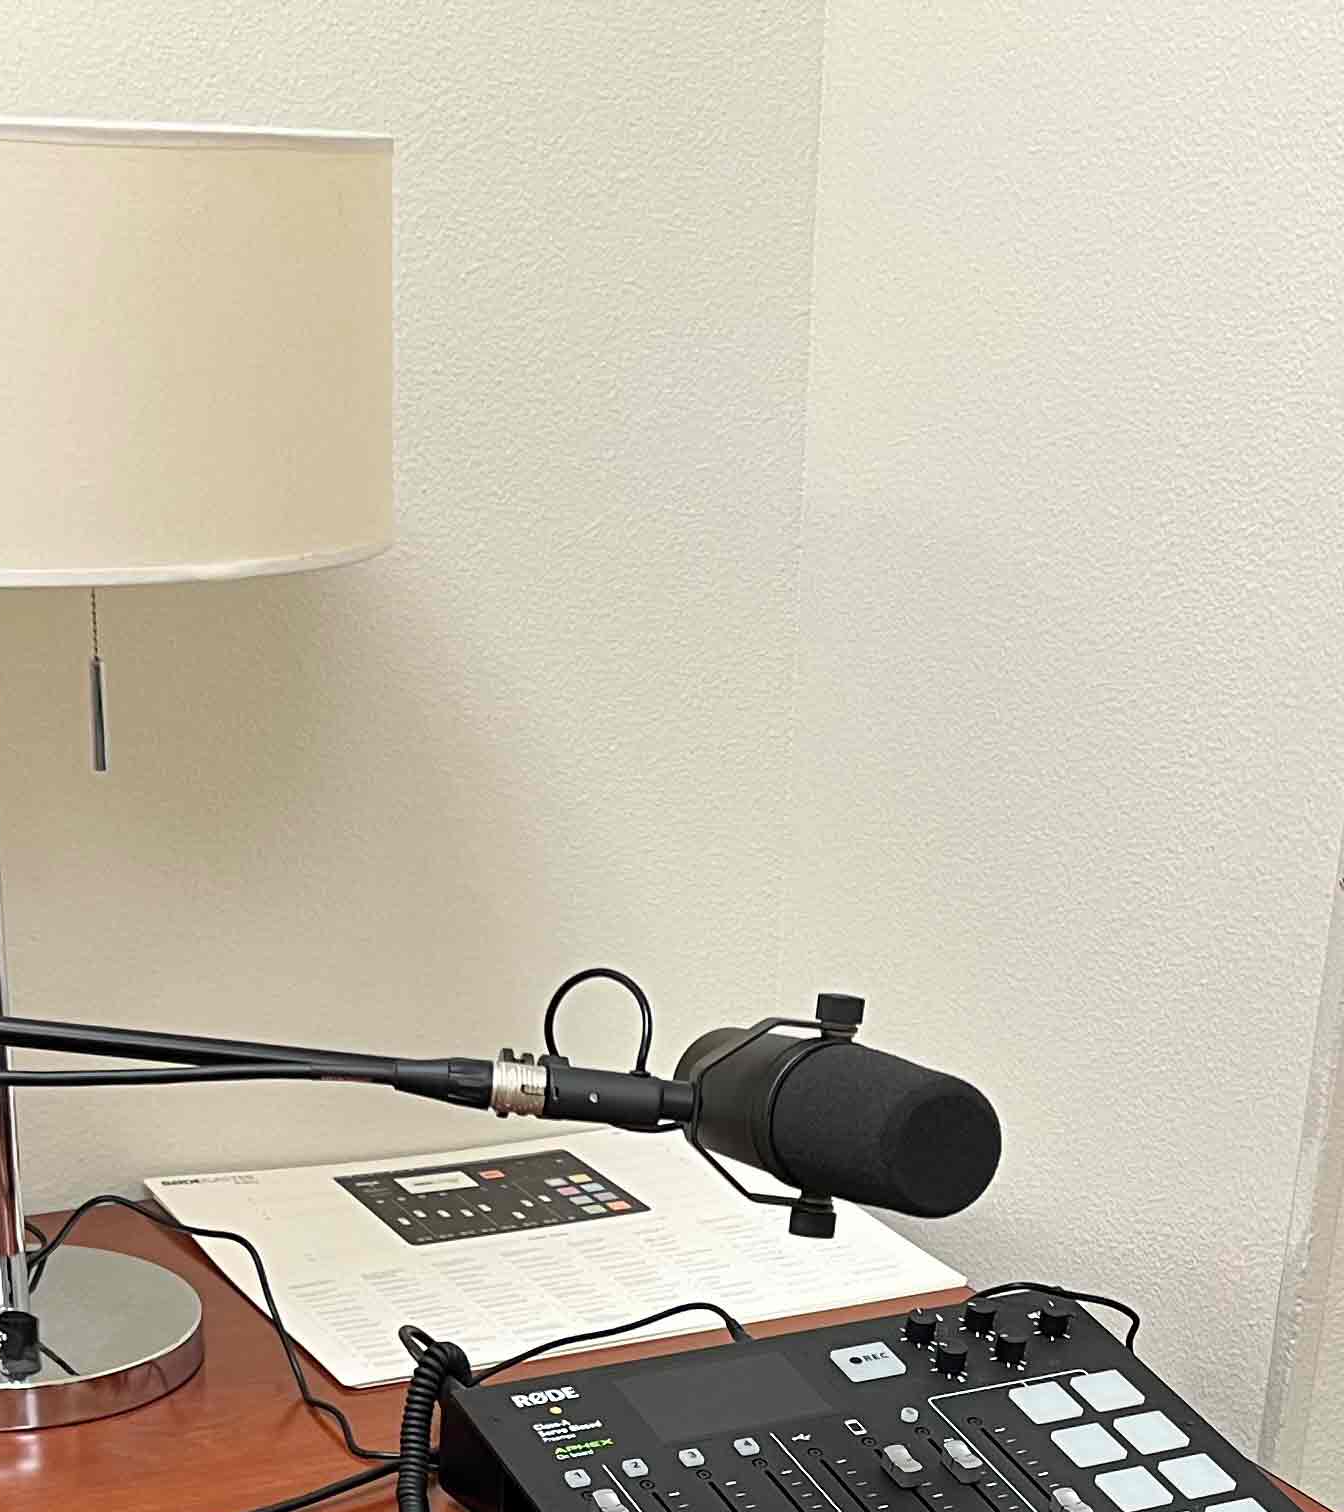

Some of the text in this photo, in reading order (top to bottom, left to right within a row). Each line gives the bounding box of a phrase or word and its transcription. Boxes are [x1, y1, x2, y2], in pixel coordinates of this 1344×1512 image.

[863, 1352, 889, 1362] REC
[511, 1386, 580, 1408] RØDE
[555, 1438, 614, 1454] APHEX
